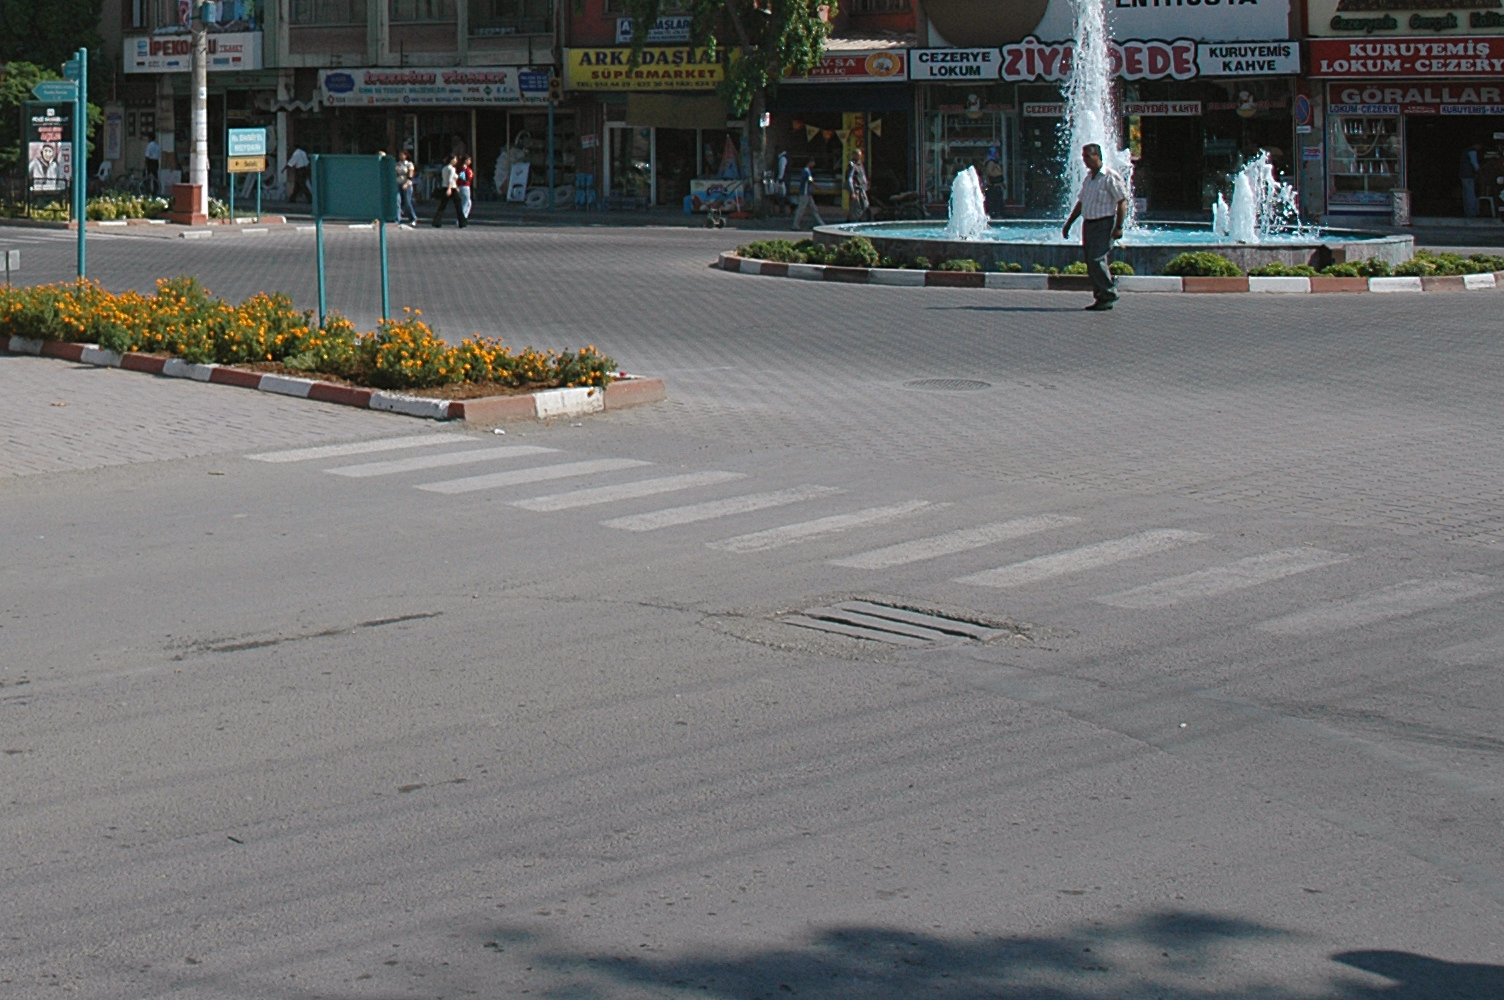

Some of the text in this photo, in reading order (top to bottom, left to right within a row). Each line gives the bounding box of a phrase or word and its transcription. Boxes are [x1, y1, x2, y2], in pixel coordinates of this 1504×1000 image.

[149, 36, 217, 57] İPEKOU
[1209, 43, 1291, 59] KURUYEMİŞ
[1349, 40, 1491, 59] KURUYEMİŞ
[918, 51, 991, 63] CEZERYE
[929, 65, 981, 77] LOKUM
[1222, 60, 1276, 72] KAHVE
[1320, 59, 1401, 73] LOKUM
[591, 68, 716, 79] SÜPERMARKET
[1341, 86, 1501, 104] GÖRALLAR
